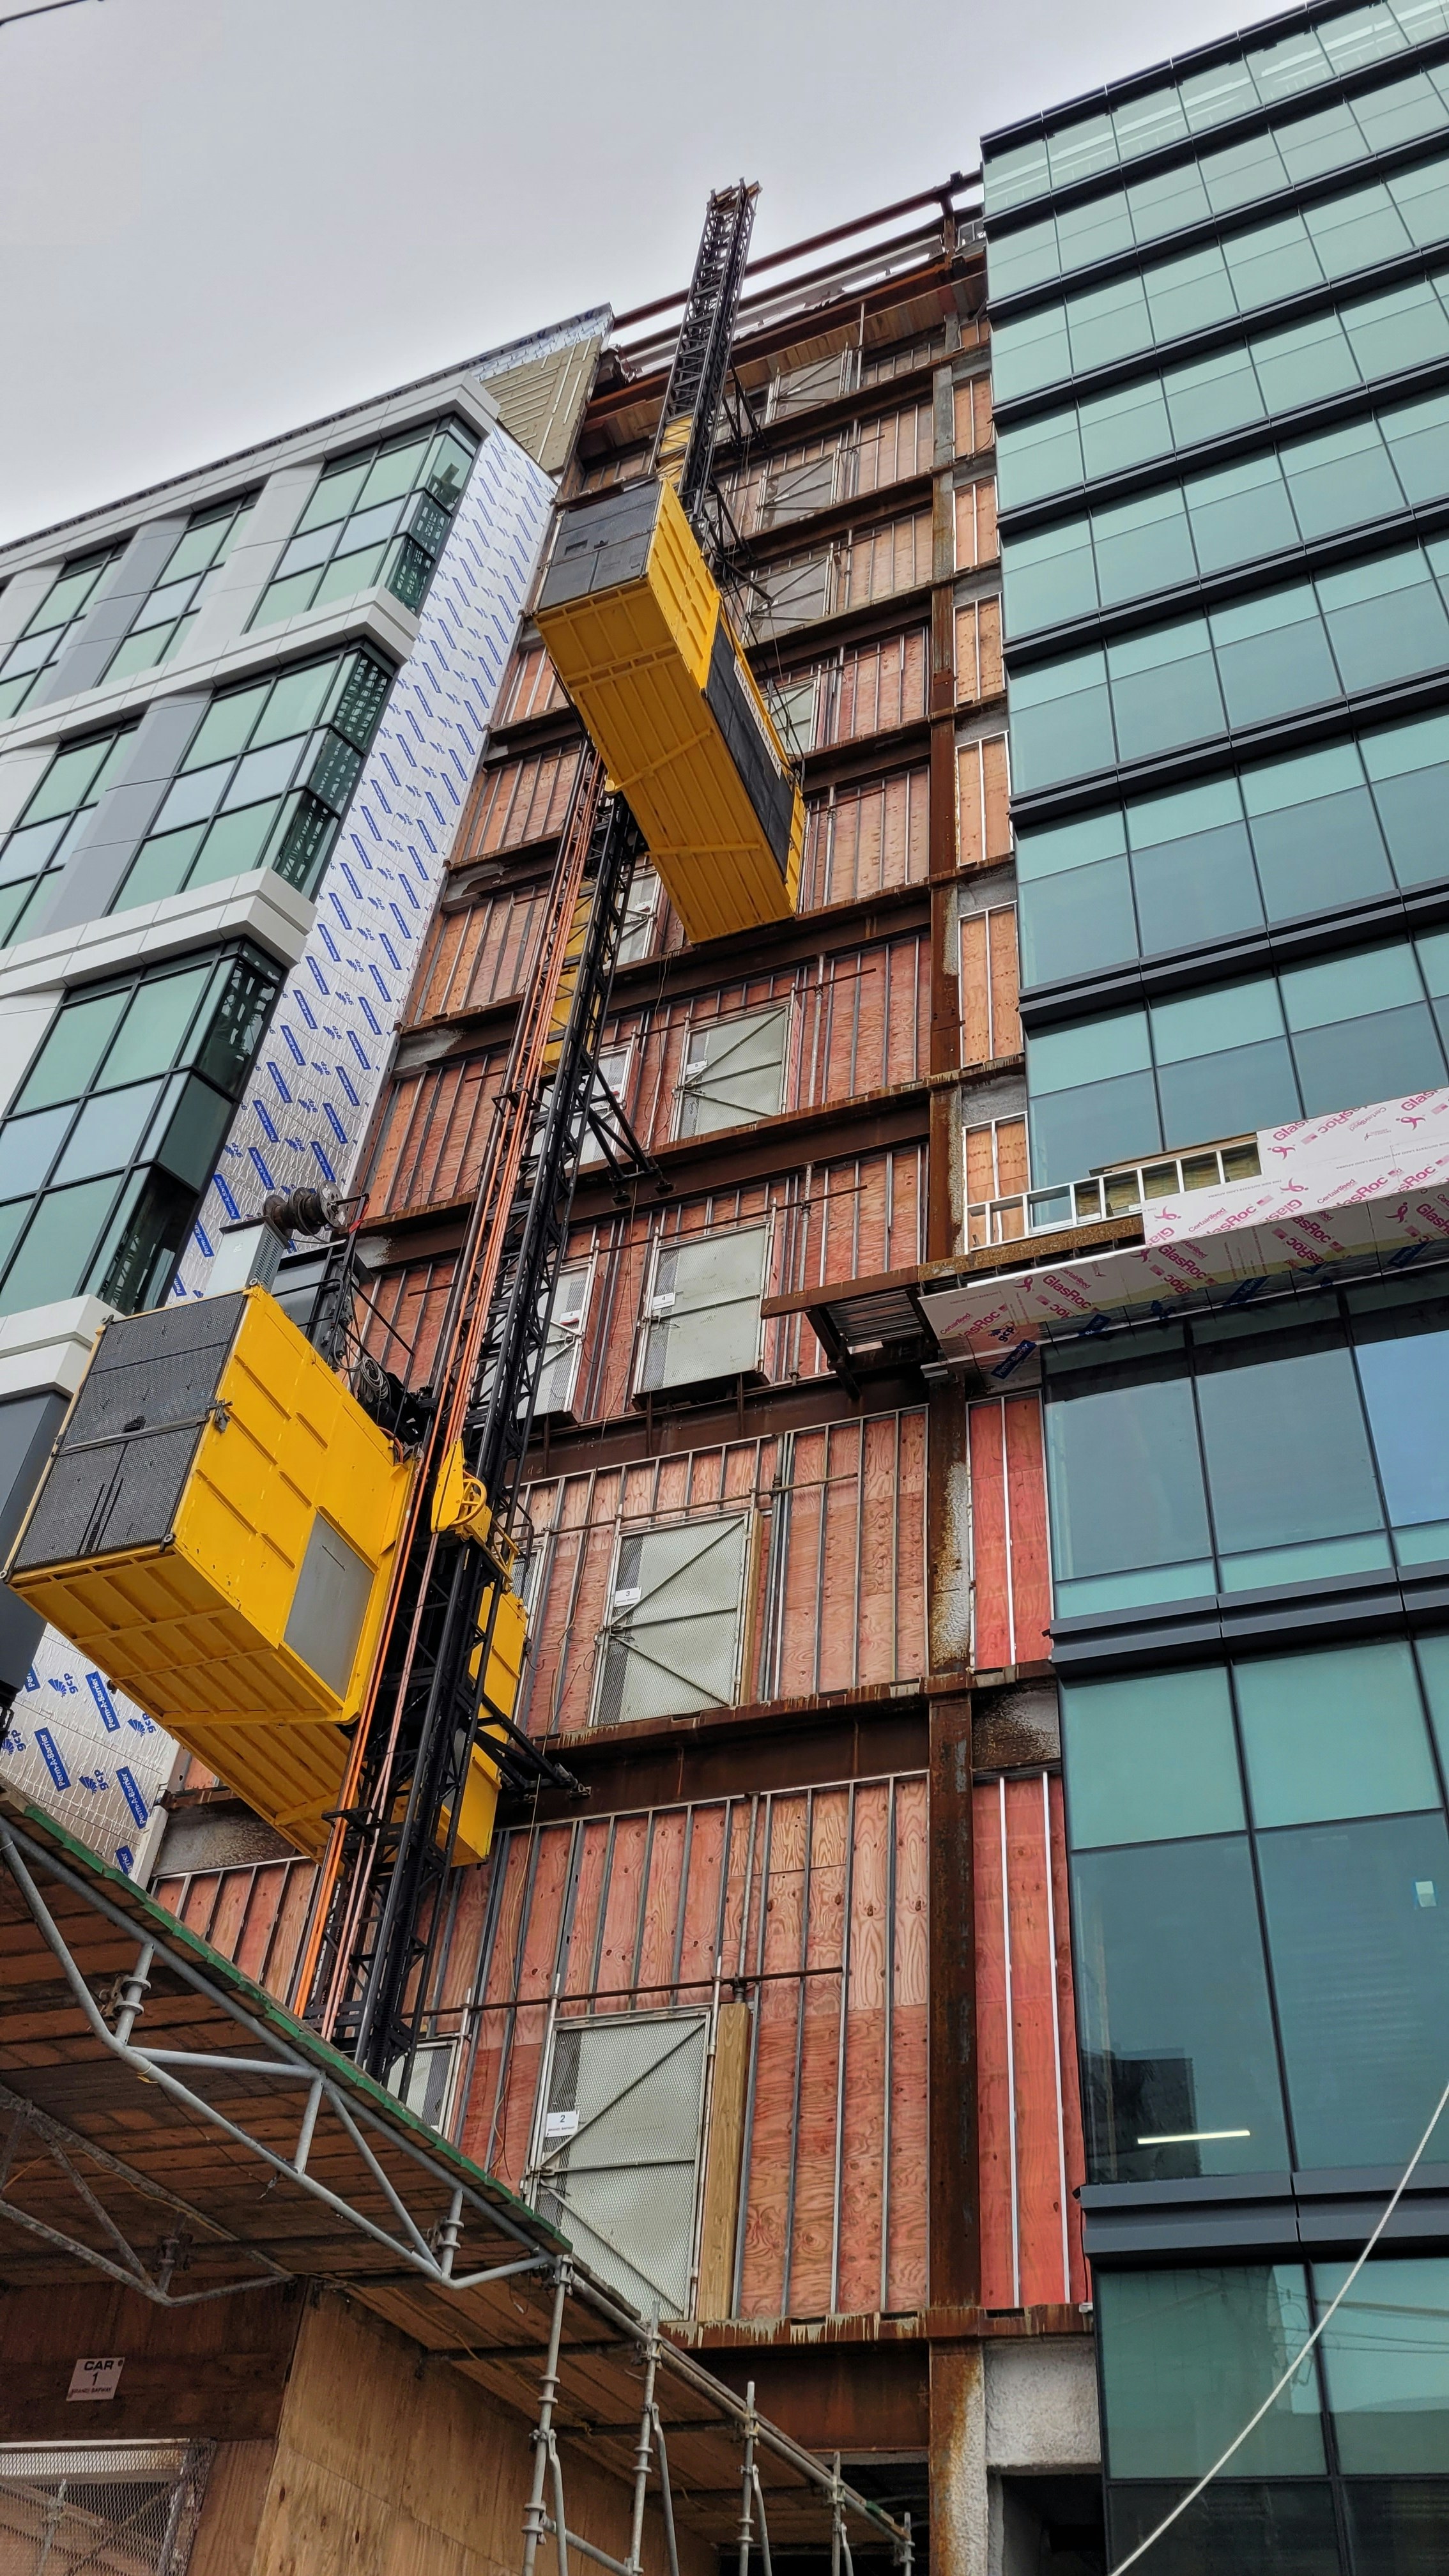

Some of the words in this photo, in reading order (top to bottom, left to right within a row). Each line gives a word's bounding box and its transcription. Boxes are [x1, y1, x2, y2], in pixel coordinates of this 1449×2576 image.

[1401, 1090, 1438, 1111] Glas
[1273, 1120, 1309, 1141] Glas
[1317, 1179, 1355, 1204] CertainTeed
[1188, 1208, 1226, 1232] CertainTeed
[1265, 1199, 1303, 1221] Glas
[1158, 1245, 1206, 1279] GlasRoc
[1043, 1275, 1092, 1309] GlasRoc
[998, 1326, 1015, 1342] gcp
[64, 1673, 79, 1694] gcp
[91, 1675, 116, 1729] Perm-A-Barrier
[11, 1729, 27, 1752] gcp
[40, 1733, 69, 1788] Perm-A-Barrier
[94, 1769, 109, 1791] gcp
[121, 1772, 147, 1825] Perm-A-Barrier
[560, 2115, 565, 2123] 2
[84, 2360, 114, 2371] CAR
[92, 2372, 98, 2386] 1
